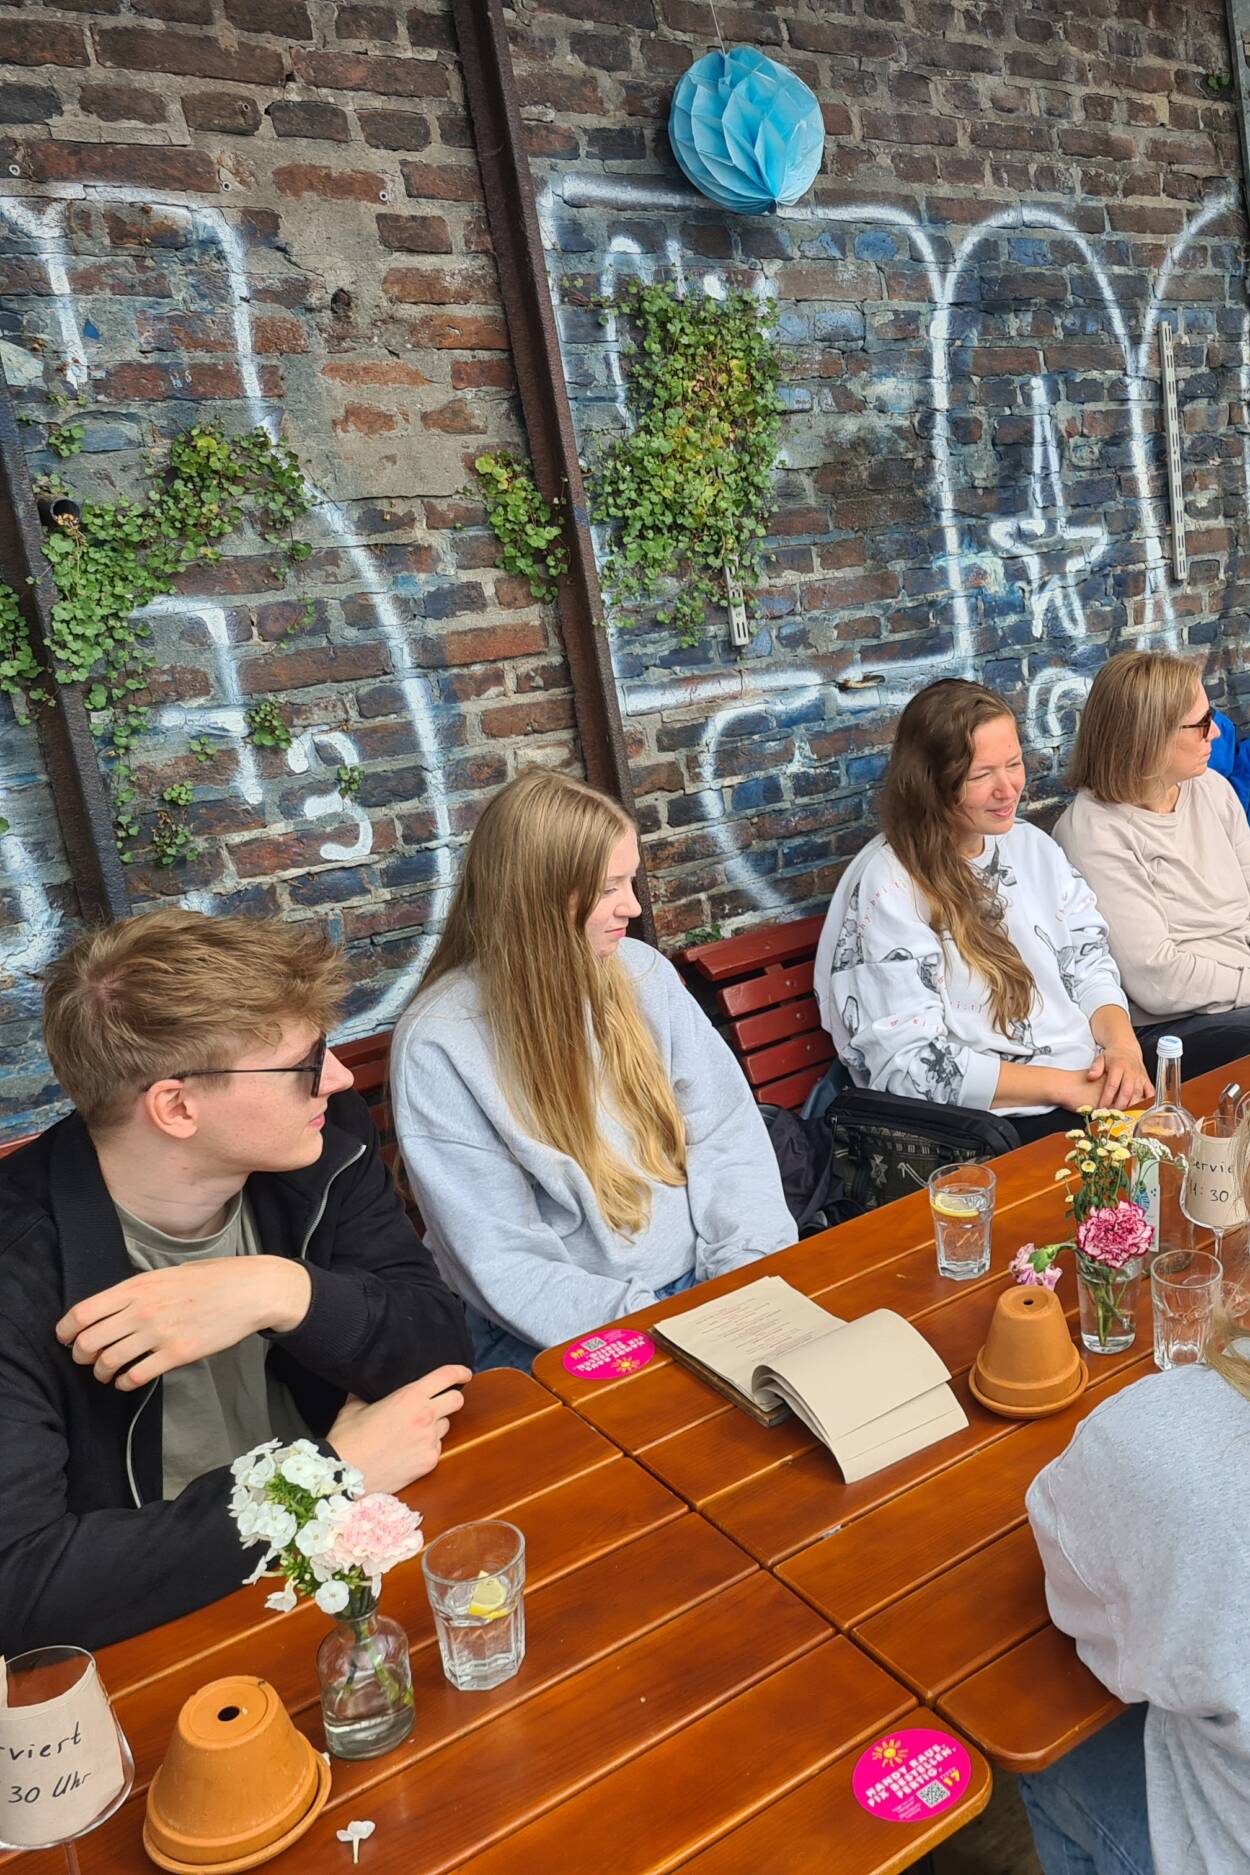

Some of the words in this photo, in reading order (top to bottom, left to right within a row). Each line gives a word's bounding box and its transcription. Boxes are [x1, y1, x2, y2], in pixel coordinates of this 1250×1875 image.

[8, 1786, 41, 1803] 30
[52, 1770, 92, 1798] Uhr
[865, 1765, 907, 1797] HANDY
